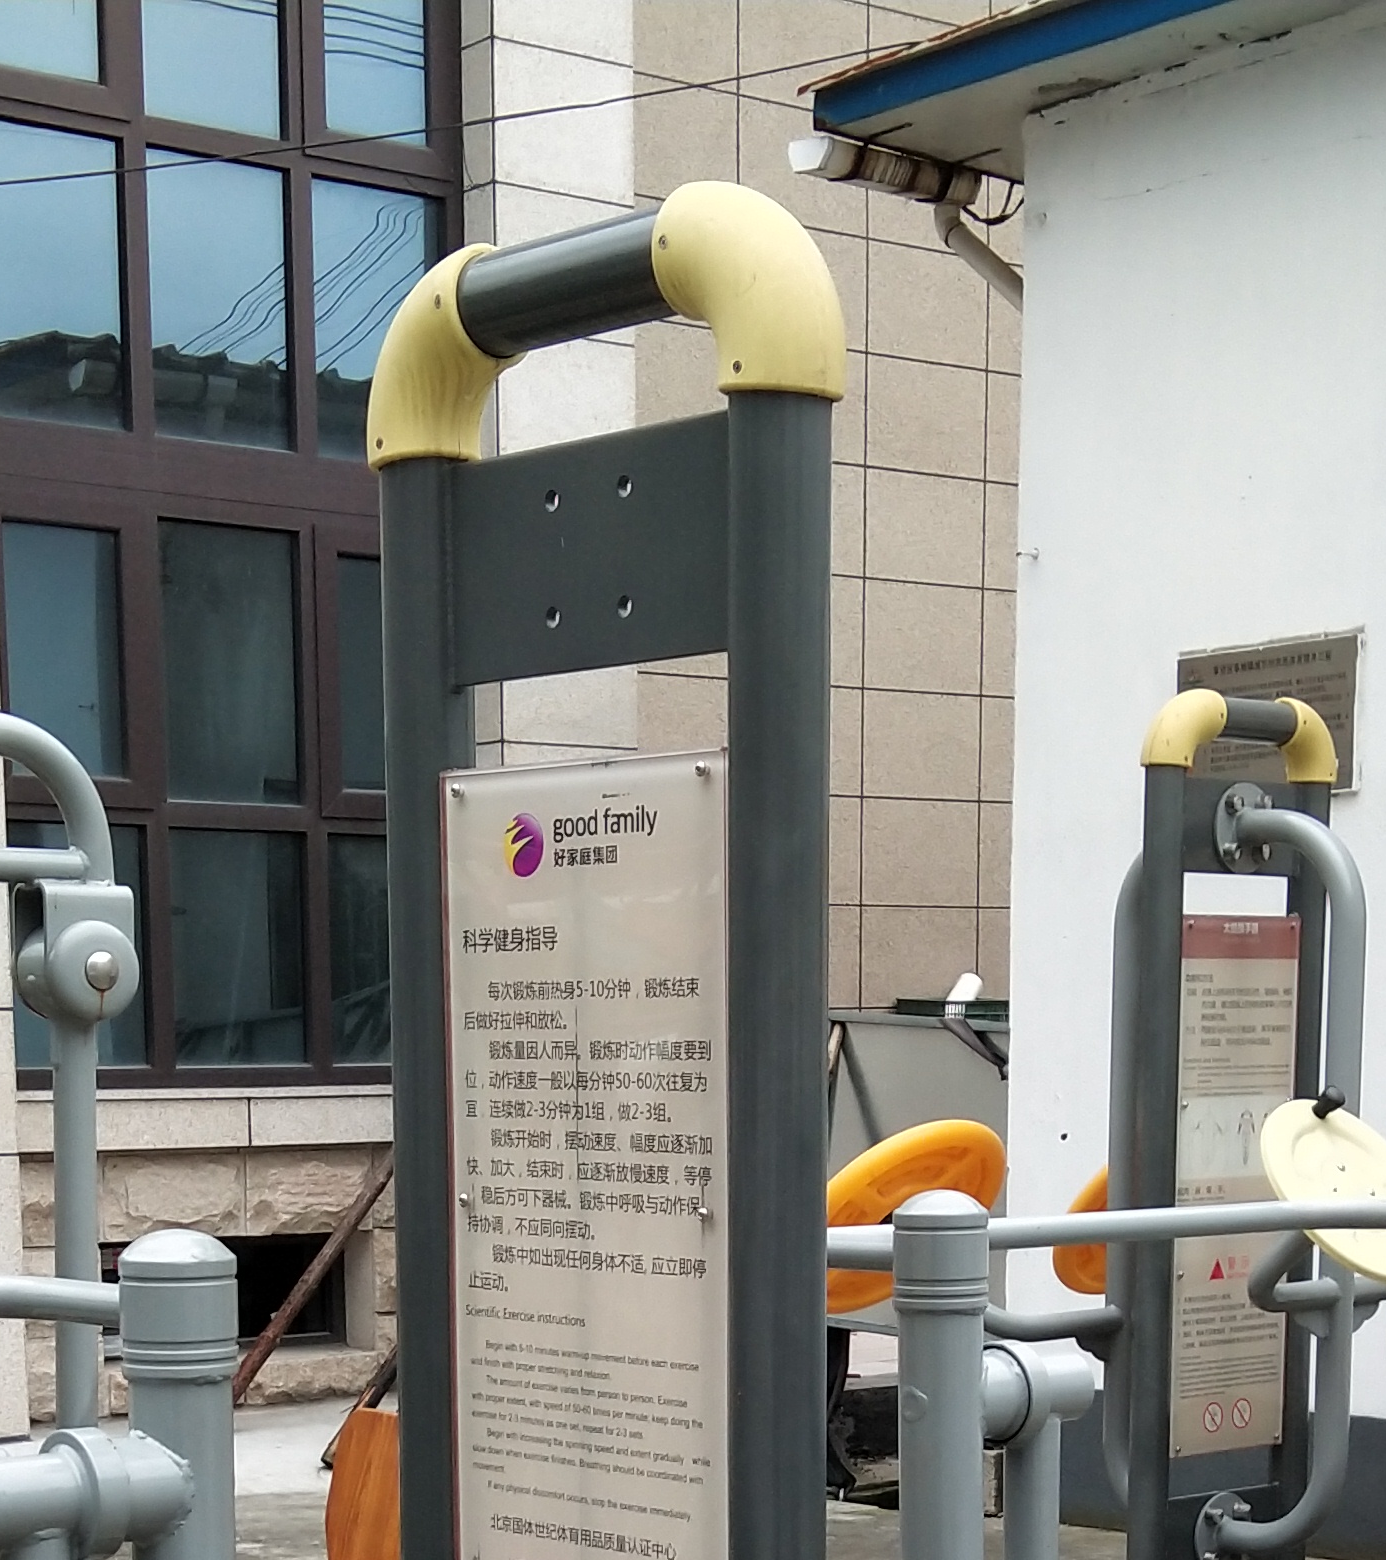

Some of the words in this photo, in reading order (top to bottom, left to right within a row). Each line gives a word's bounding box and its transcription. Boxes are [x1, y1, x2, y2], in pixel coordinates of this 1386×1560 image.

[553, 809, 599, 843] good
[602, 804, 659, 837] family
[553, 845, 618, 868] 好家庭集团
[462, 926, 558, 954] 科学健身指导
[490, 1513, 677, 1560] 北京国体世纪体育用品质量认证中心
